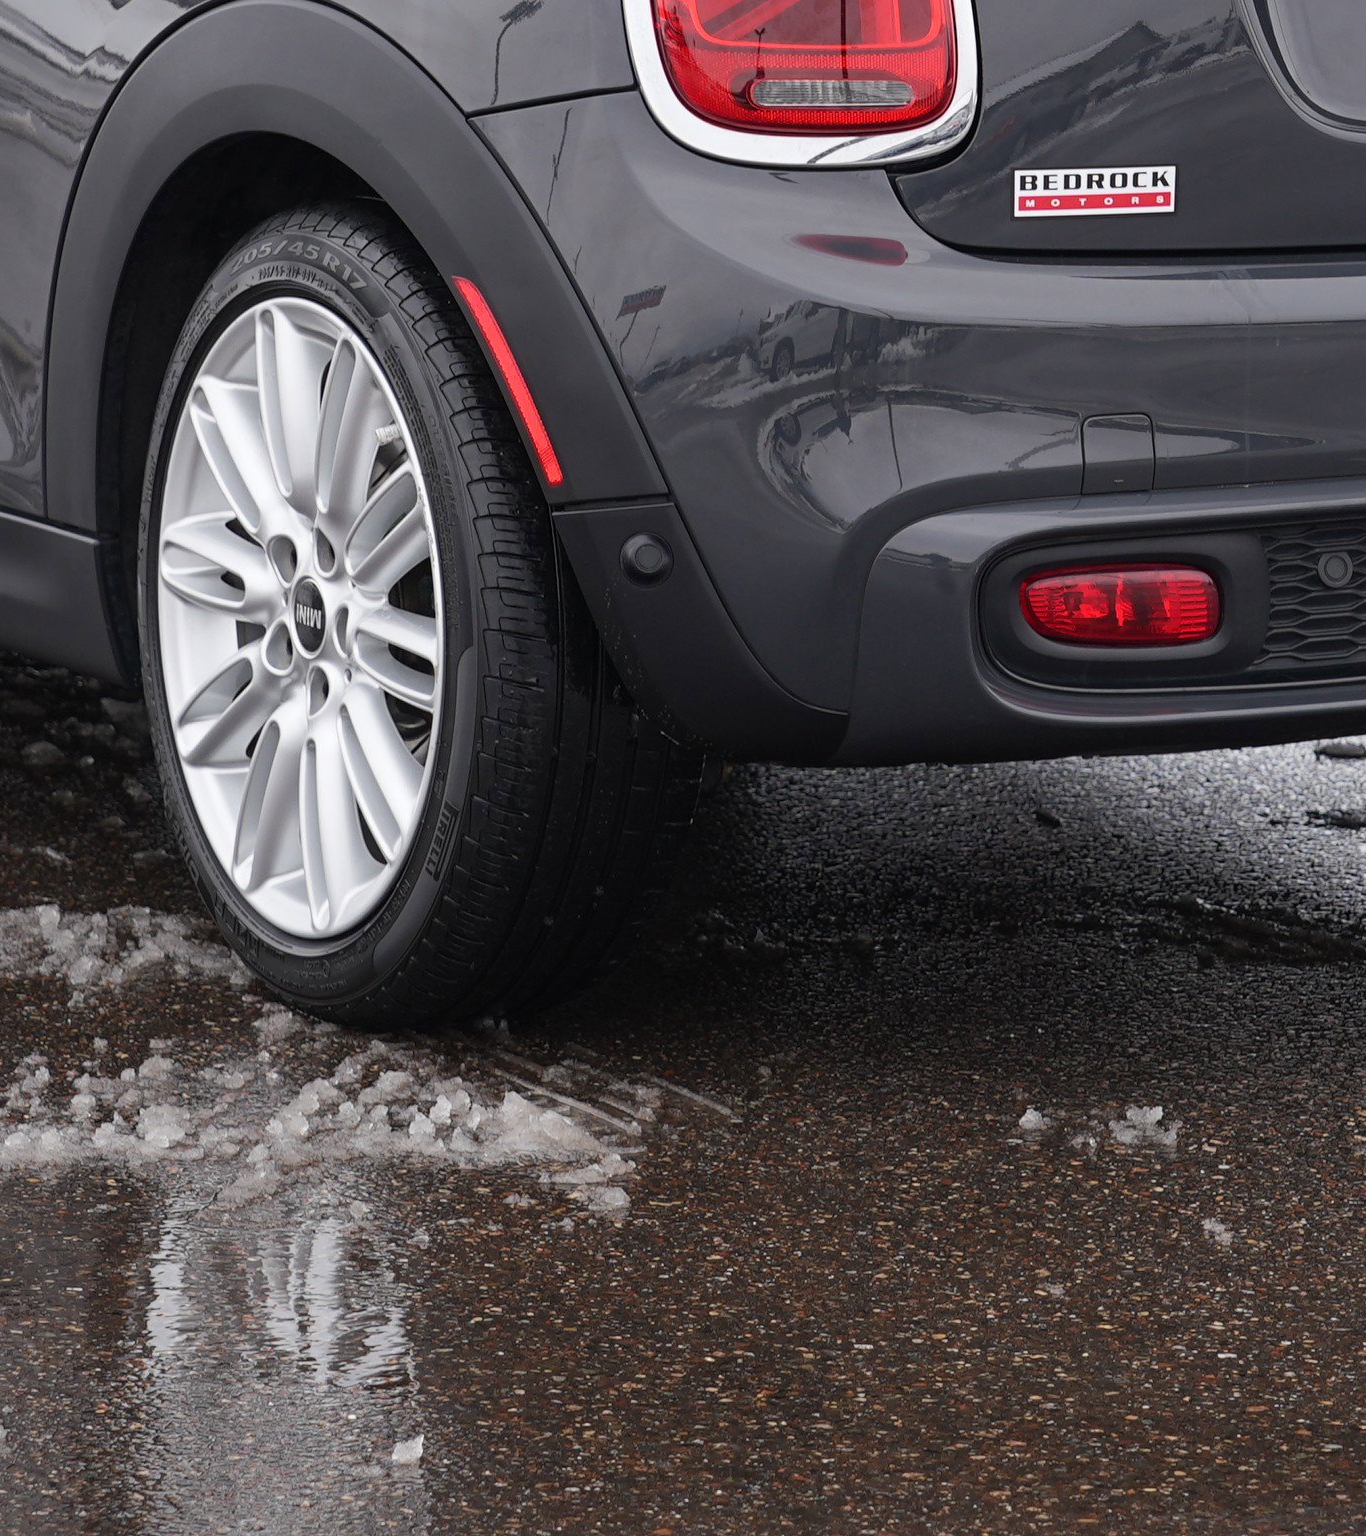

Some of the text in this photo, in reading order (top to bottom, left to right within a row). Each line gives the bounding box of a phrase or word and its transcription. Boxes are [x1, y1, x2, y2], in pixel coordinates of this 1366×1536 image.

[1020, 171, 1169, 191] BEDROCK
[1026, 195, 1164, 208] MOTORS
[296, 603, 321, 630] MINI
